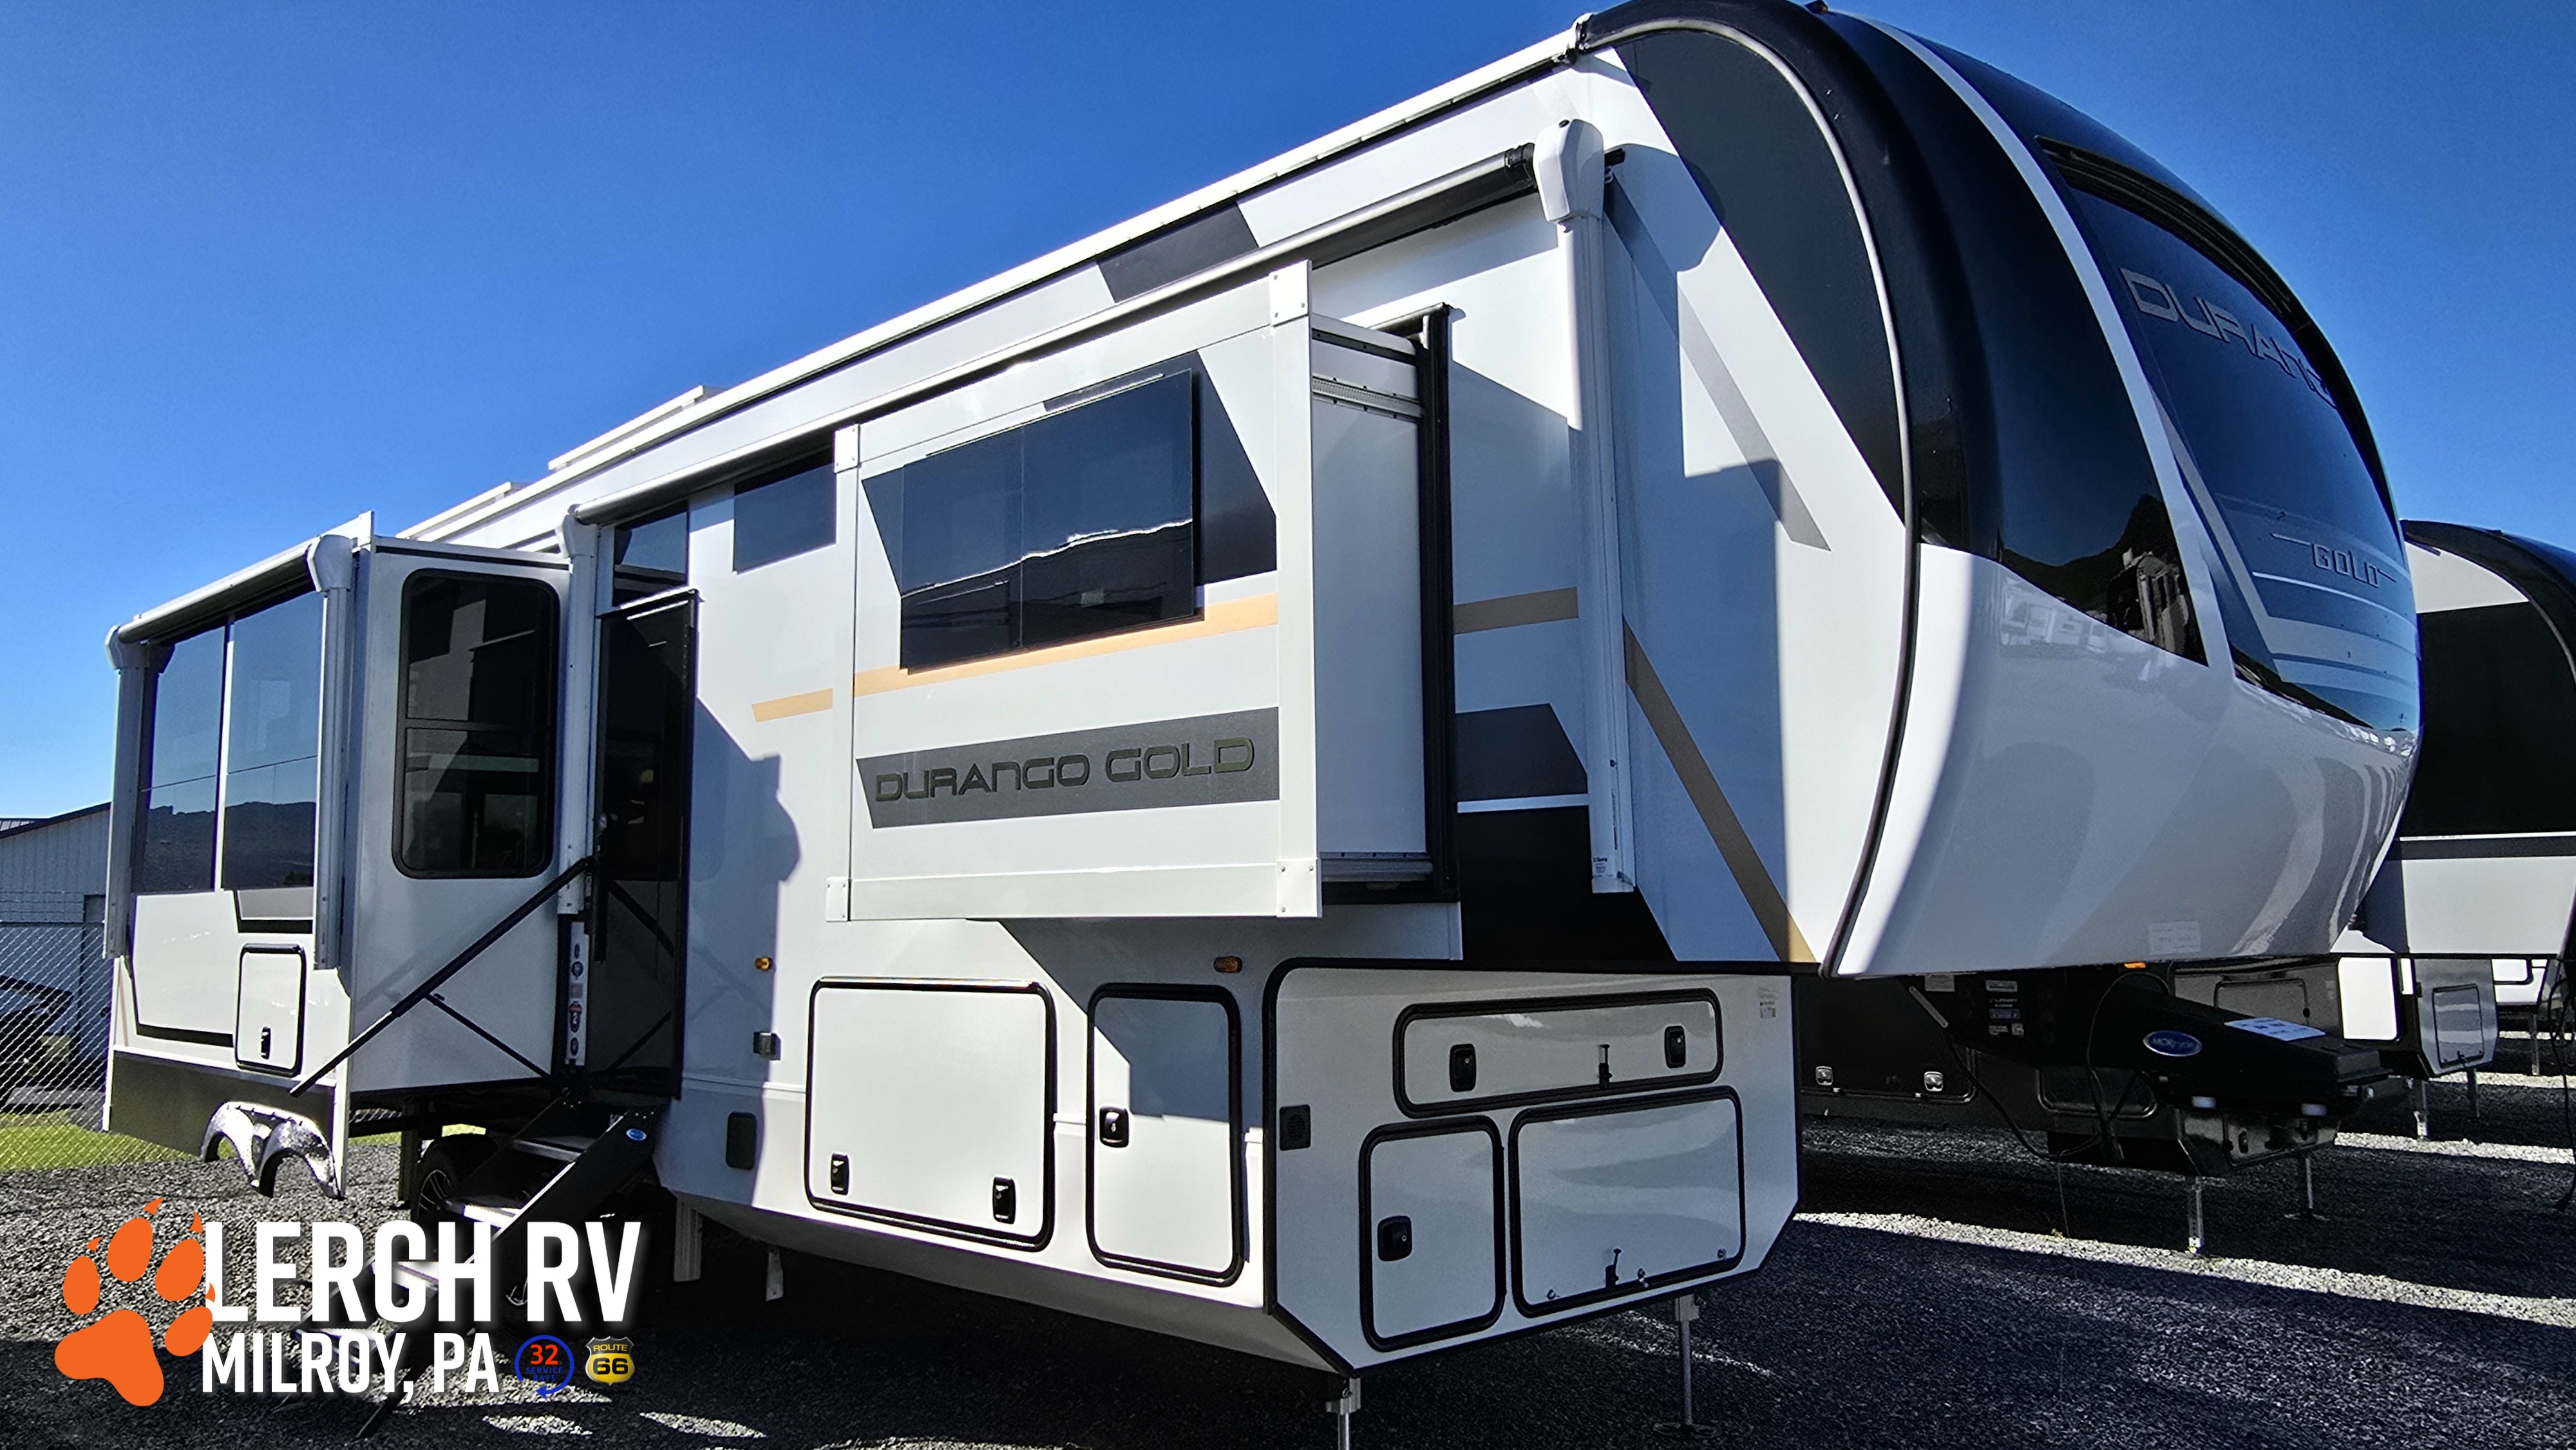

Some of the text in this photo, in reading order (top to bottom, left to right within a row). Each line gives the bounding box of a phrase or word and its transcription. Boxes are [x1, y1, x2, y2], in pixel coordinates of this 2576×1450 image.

[2119, 267, 2338, 410] DURANG
[2311, 543, 2379, 588] GOLD
[876, 737, 1255, 802] DURANGO GOLD
